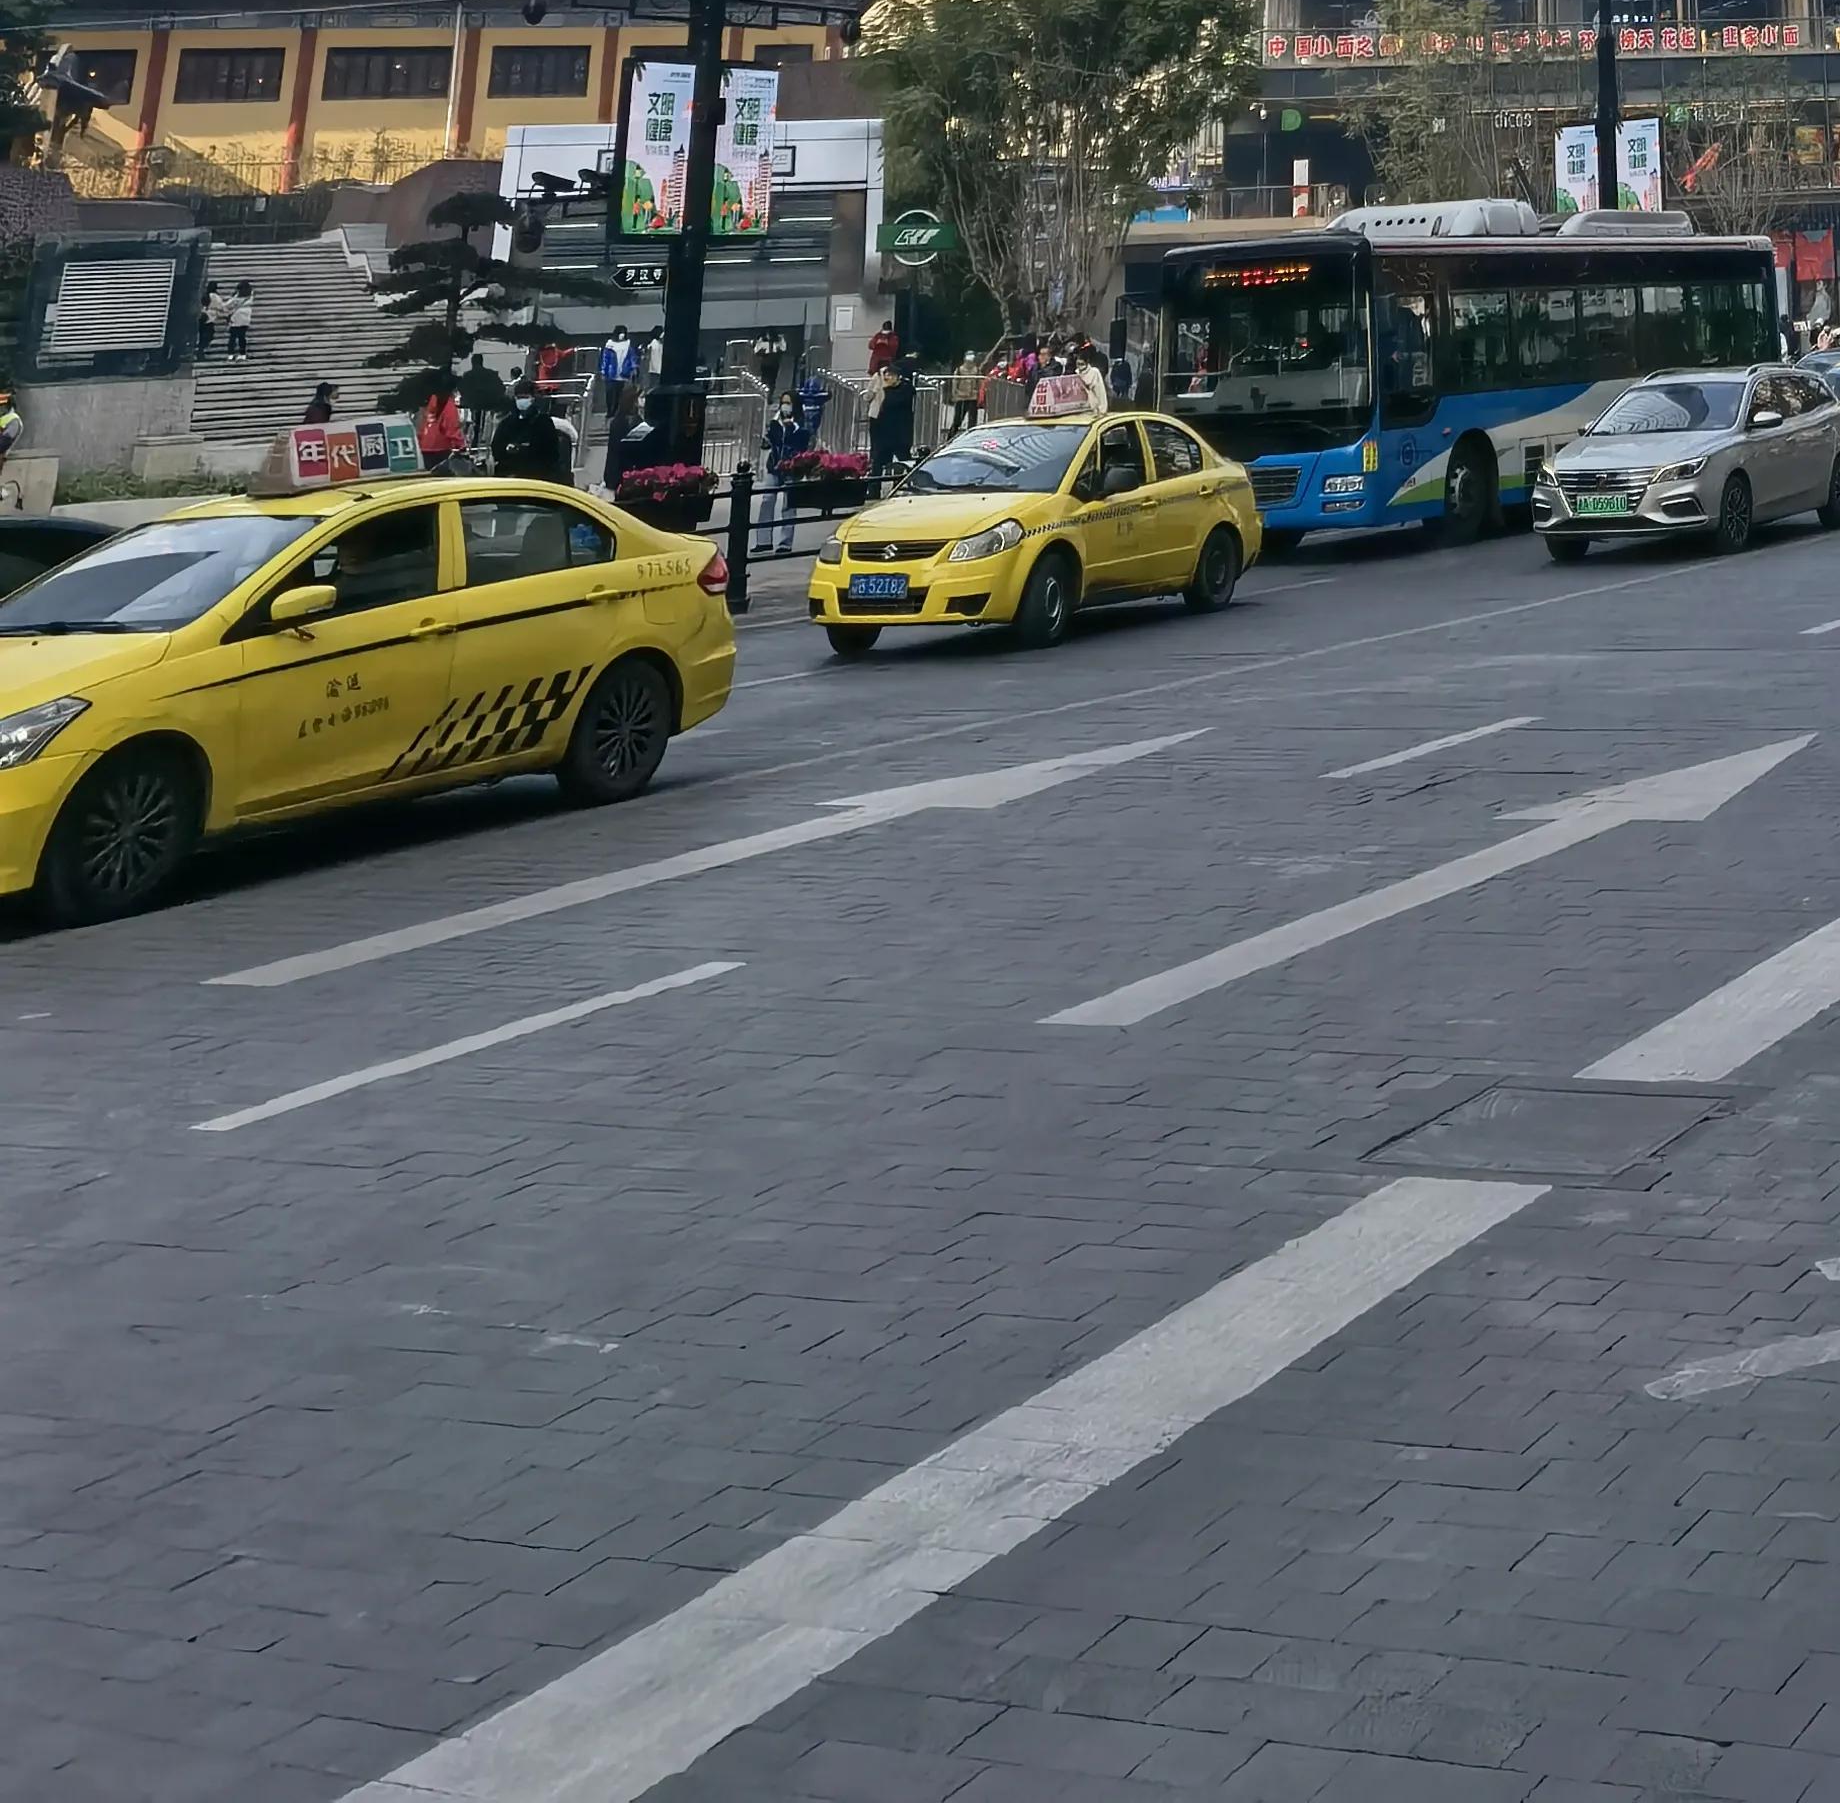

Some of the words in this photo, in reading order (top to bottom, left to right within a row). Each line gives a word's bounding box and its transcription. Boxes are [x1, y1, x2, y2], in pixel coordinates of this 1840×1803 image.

[647, 92, 675, 115] 文明
[298, 433, 416, 468] 年代厨卫
